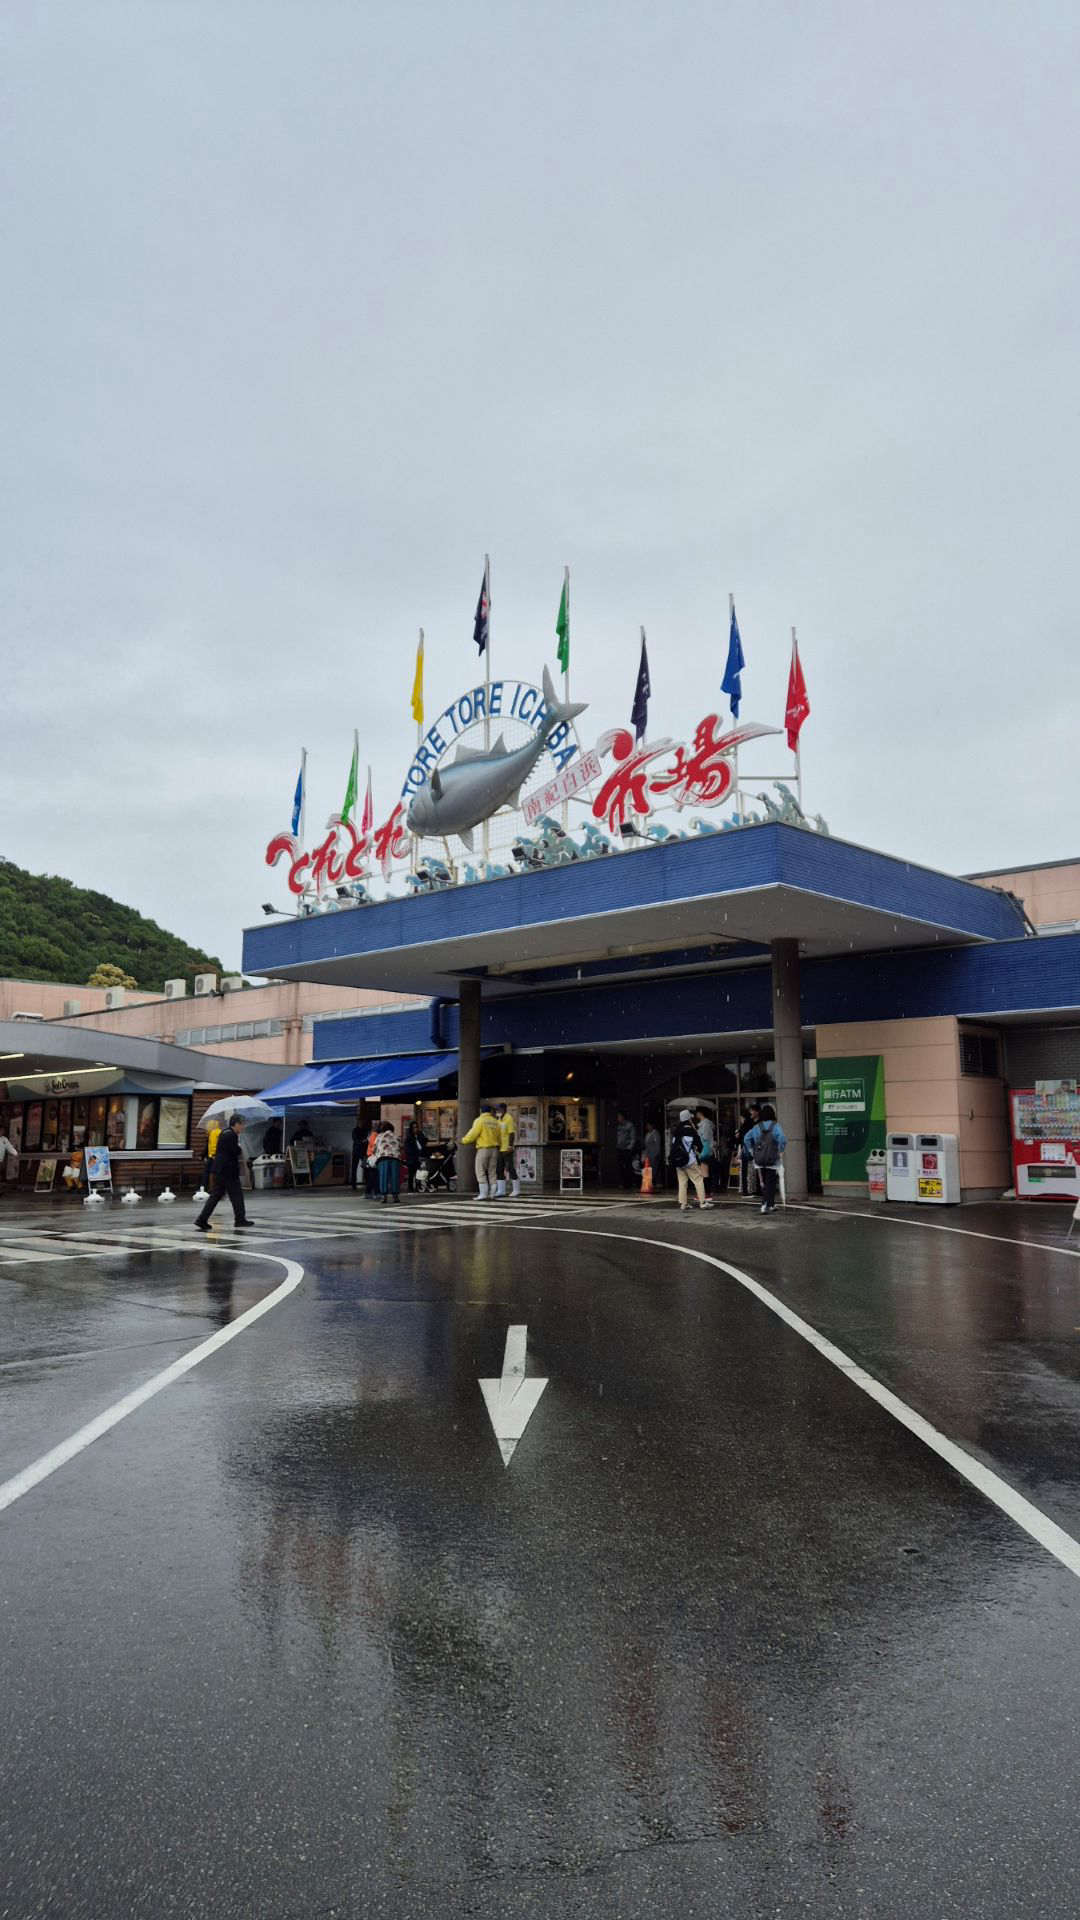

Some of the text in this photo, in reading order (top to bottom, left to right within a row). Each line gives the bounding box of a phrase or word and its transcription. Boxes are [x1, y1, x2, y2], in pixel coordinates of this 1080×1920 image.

[402, 682, 579, 797] TORE TORE ICHBA
